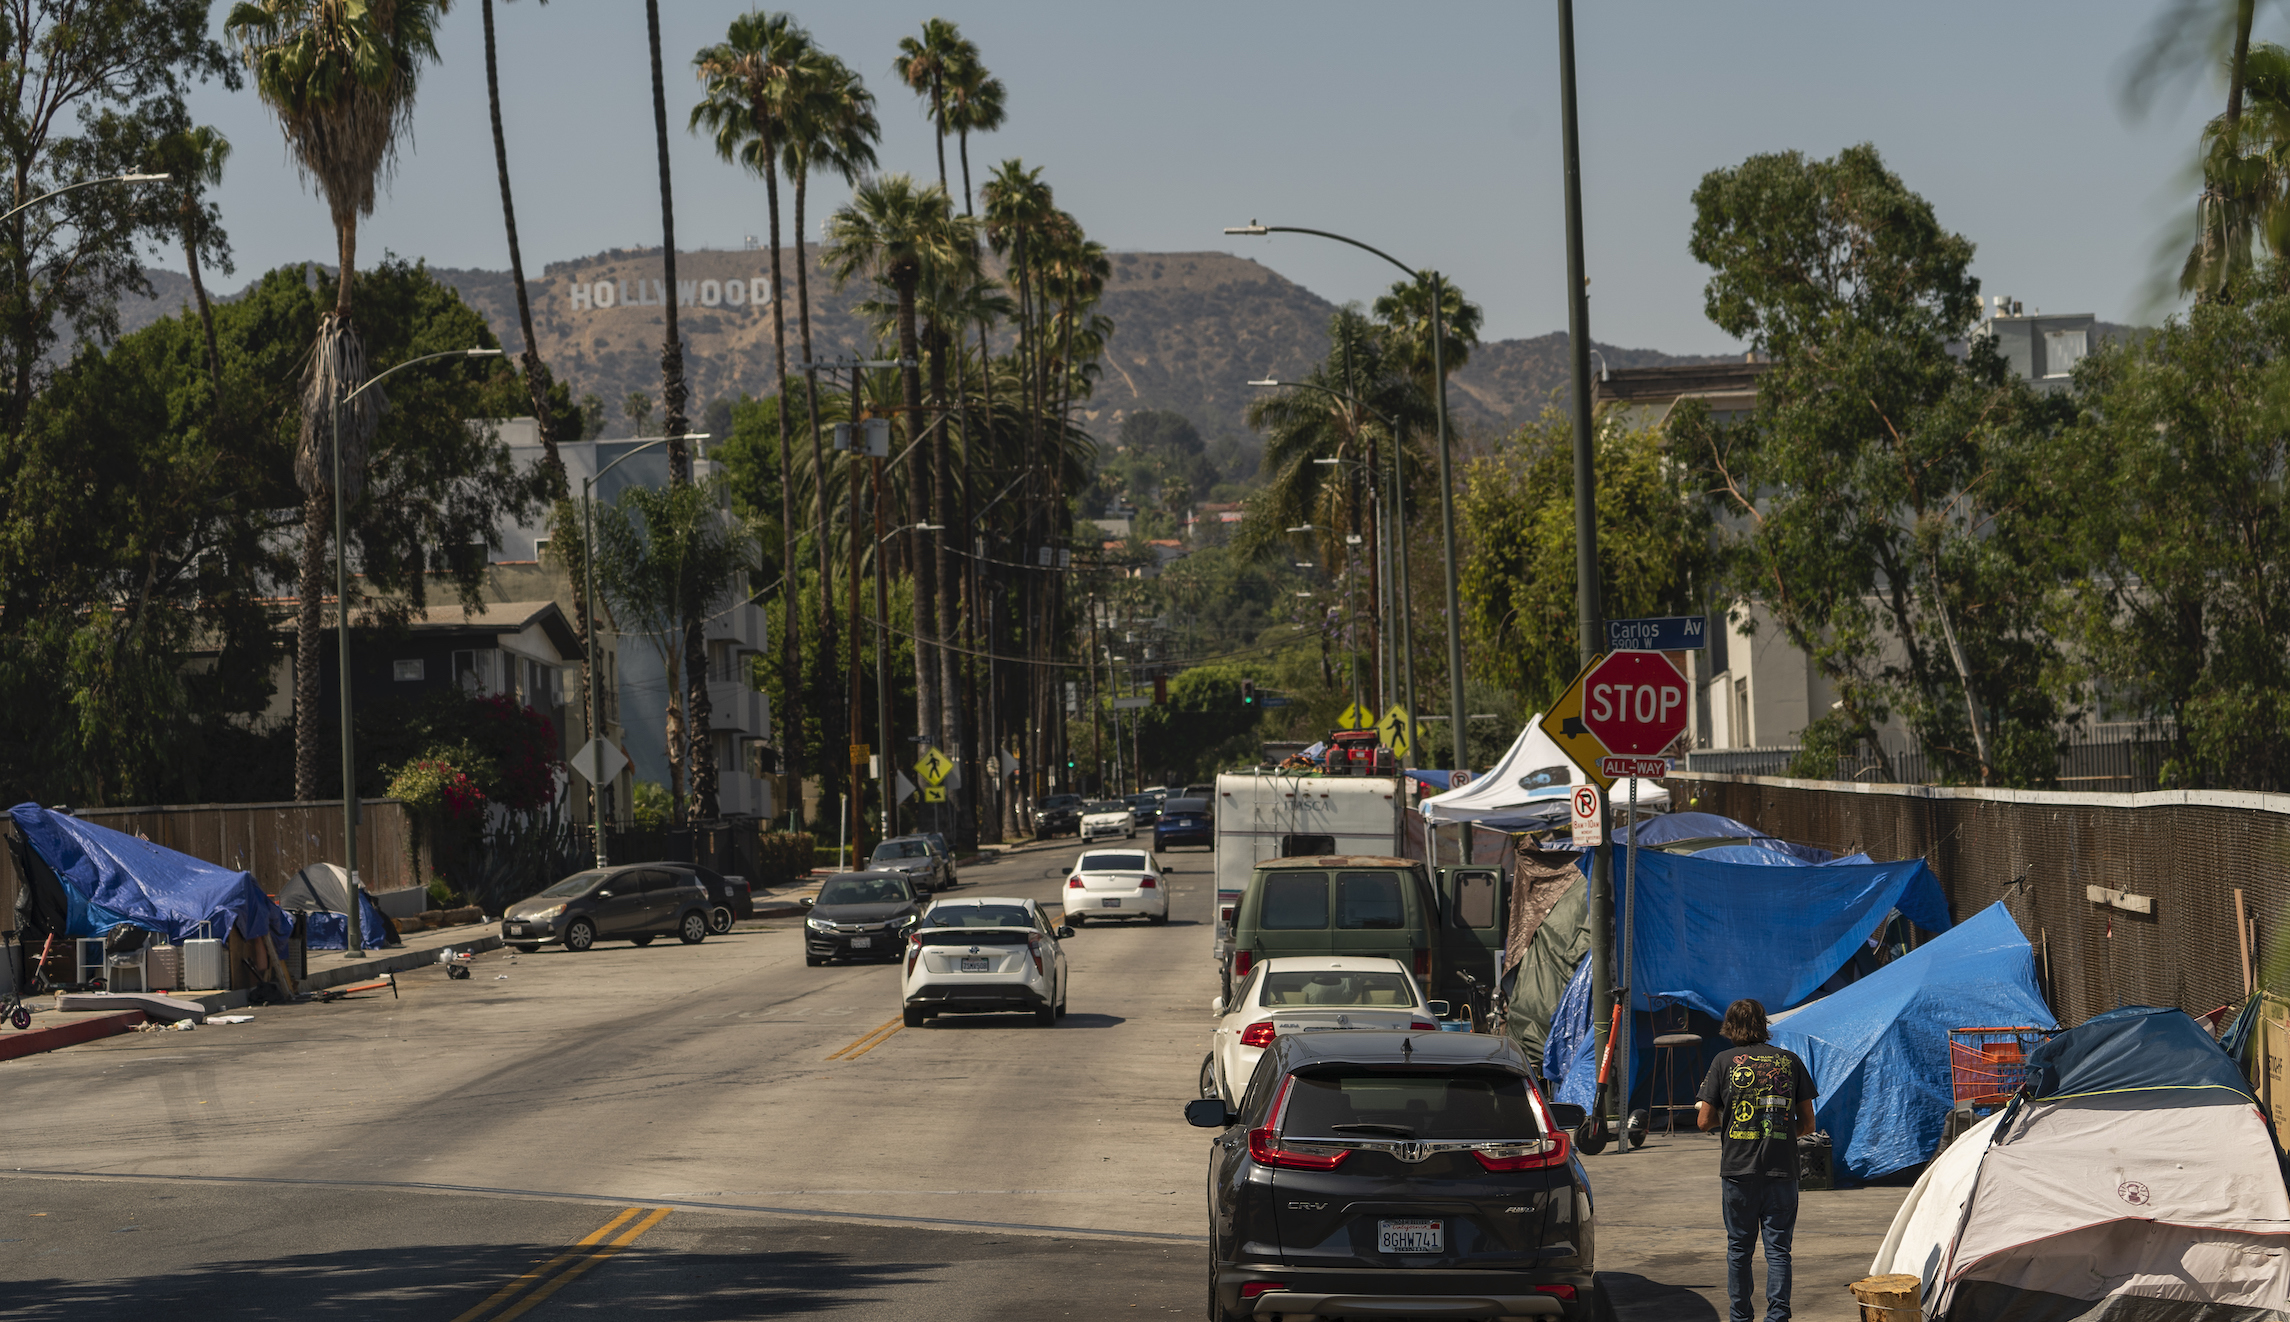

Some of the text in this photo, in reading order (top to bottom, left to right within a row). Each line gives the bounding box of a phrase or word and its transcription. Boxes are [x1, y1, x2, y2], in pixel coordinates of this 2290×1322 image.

[570, 277, 772, 311] HOLLYWOOD
[1610, 618, 1702, 639] Carlos Av
[1611, 637, 1653, 650] 5900 W
[1591, 683, 1682, 724] STOP
[1605, 760, 1664, 775] ALL-WAY
[1284, 800, 1329, 812] ITASCA
[1288, 1201, 1329, 1210] CR-V
[1383, 1232, 1439, 1247] 8GHW741
